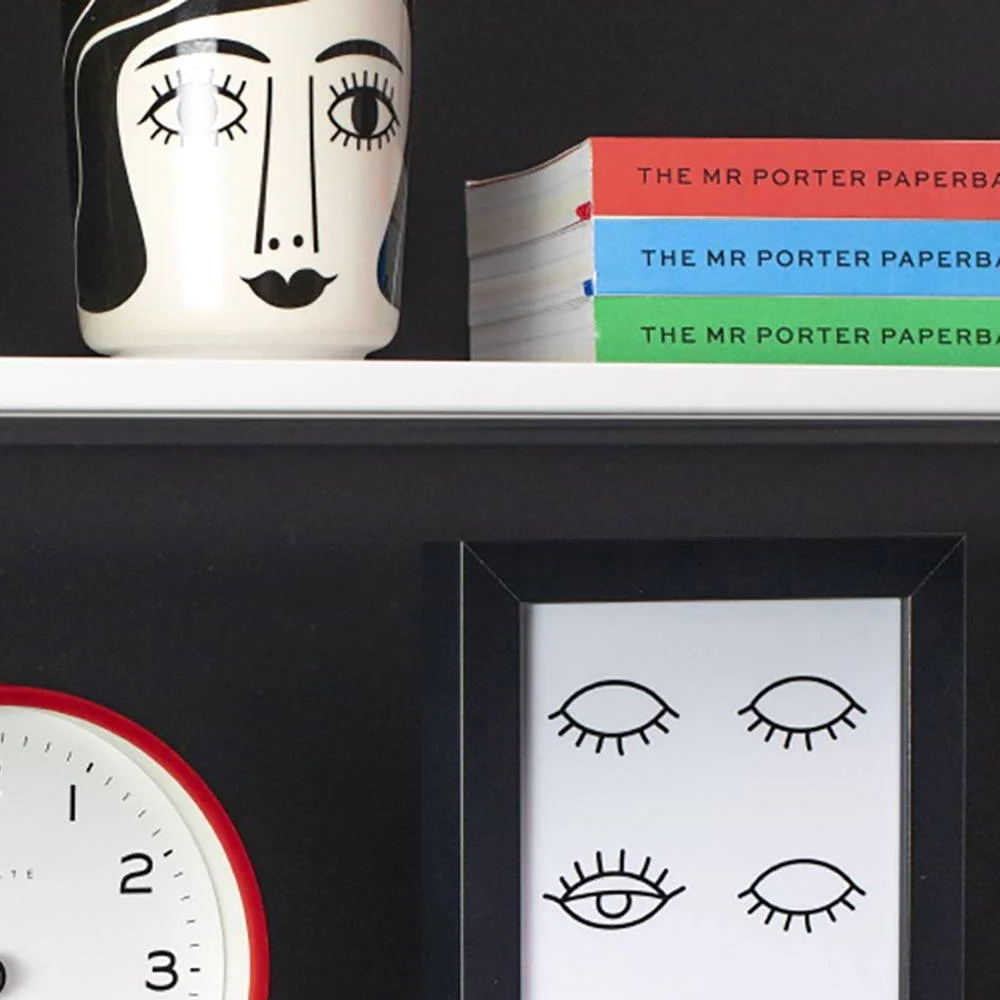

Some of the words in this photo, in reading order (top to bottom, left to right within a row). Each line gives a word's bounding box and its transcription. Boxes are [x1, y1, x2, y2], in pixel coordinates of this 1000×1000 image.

[637, 167, 692, 185] THE
[703, 167, 742, 185] MR
[753, 168, 866, 187] PORTER
[641, 249, 696, 267] THE
[707, 249, 746, 267] MR
[757, 249, 870, 267] PORTER
[881, 250, 1000, 268] PAPERB
[640, 326, 696, 344] THE
[707, 326, 745, 344] MR
[757, 326, 870, 345] PORTER
[881, 328, 1000, 345] PAPERB
[69, 784, 76, 822] 1
[119, 852, 154, 895] 2
[145, 949, 179, 992] 3
